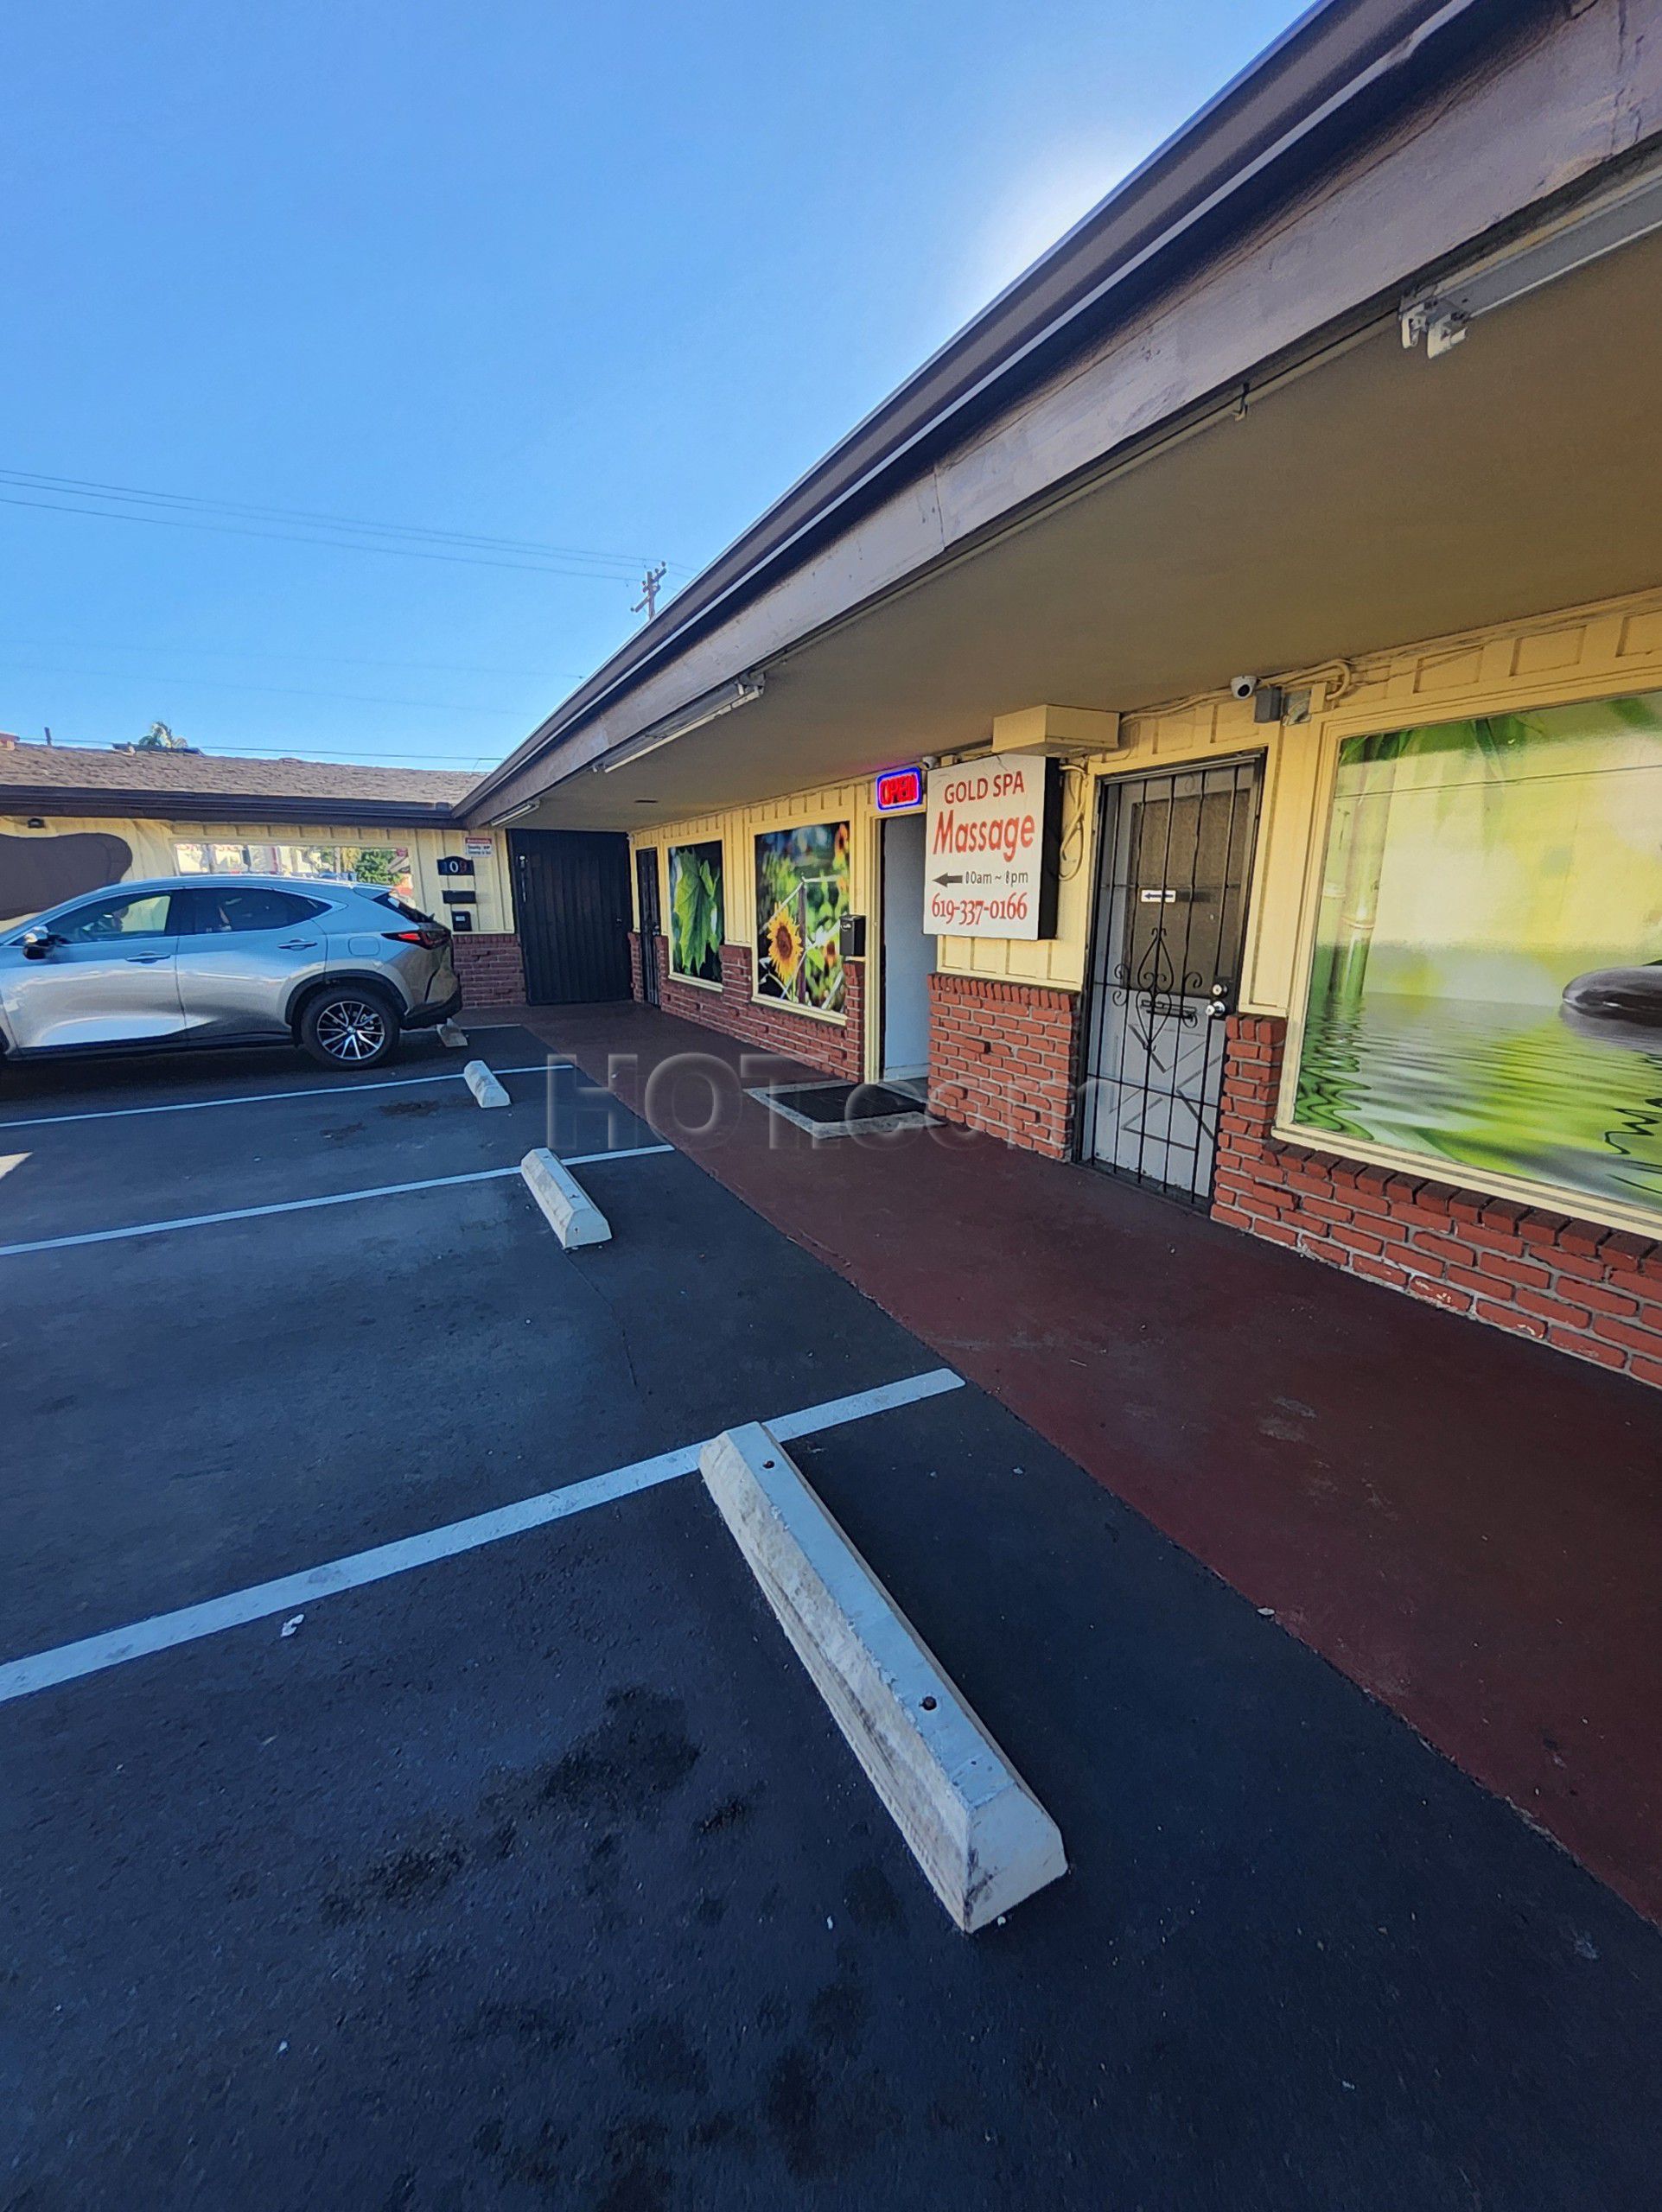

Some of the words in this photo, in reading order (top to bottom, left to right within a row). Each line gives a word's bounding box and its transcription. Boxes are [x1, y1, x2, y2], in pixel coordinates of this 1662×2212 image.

[880, 773, 918, 805] OPEN
[944, 778, 989, 804] GOLD
[993, 771, 1025, 798] SPA
[933, 810, 1035, 862] Massage
[965, 870, 992, 884] 10am
[932, 892, 1028, 925] 619-337-0166
